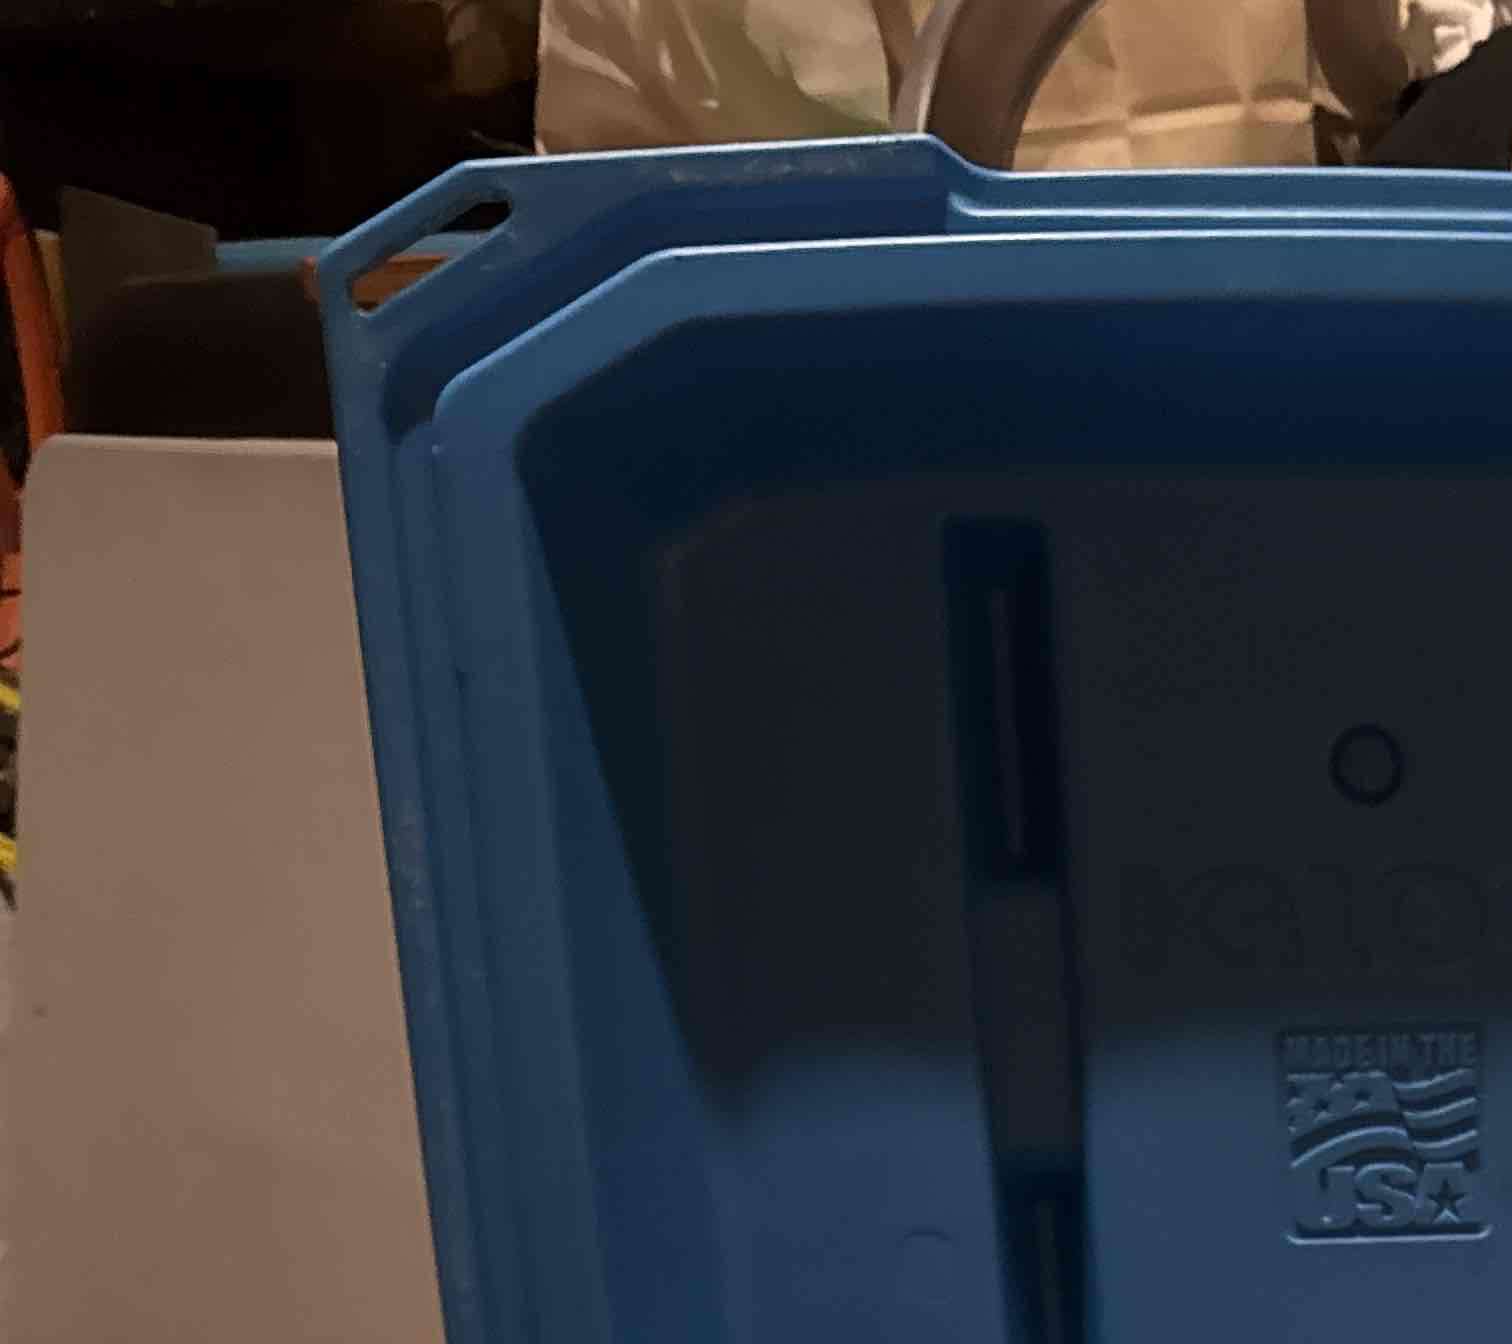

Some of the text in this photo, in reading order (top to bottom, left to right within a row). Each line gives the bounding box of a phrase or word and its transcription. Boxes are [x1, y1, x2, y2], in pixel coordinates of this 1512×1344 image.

[1286, 1031, 1477, 1069] MADE IN THE
[1296, 1161, 1480, 1228] USA
